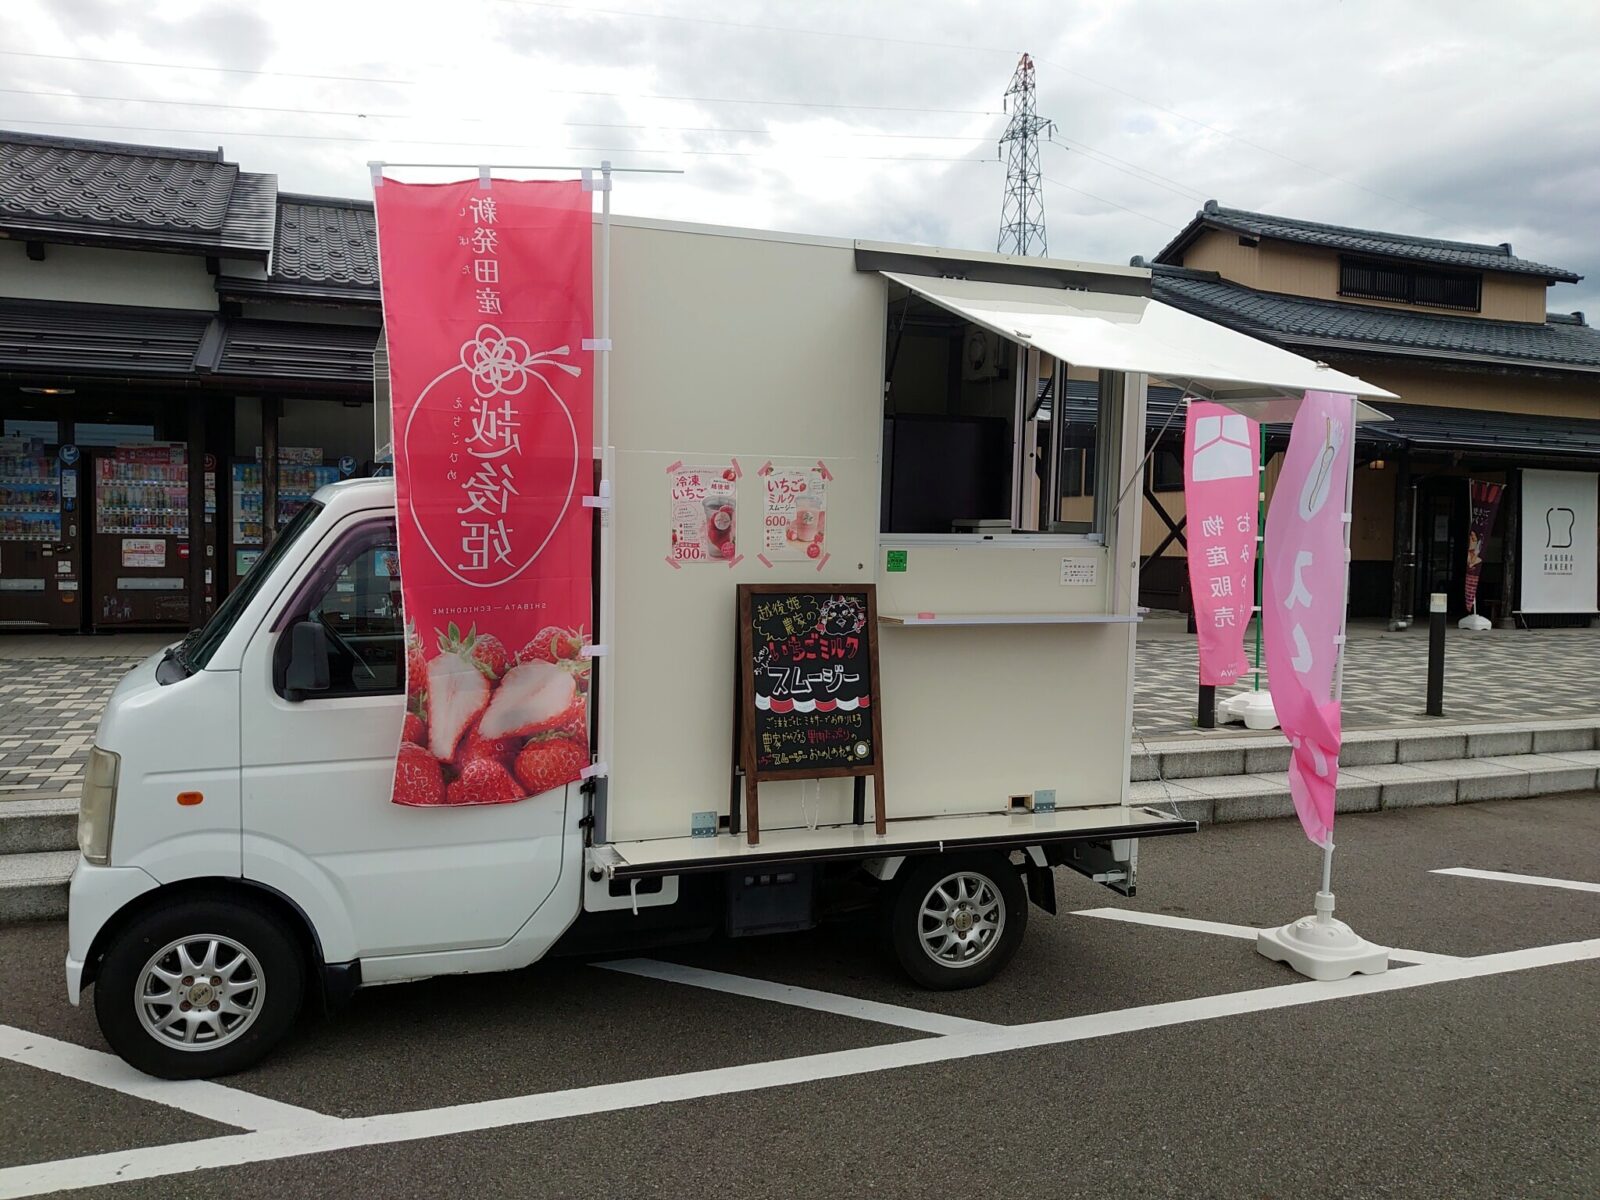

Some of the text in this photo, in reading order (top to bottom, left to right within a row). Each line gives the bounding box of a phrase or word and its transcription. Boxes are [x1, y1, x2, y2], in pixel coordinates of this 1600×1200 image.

[676, 475, 701, 487] 冷凍
[768, 478, 804, 493] いちご
[673, 488, 707, 499] いちご
[769, 494, 795, 503] ミルク
[758, 597, 801, 621] 越後姫
[768, 633, 859, 662] いちごミルク
[768, 664, 860, 695] スムージー
